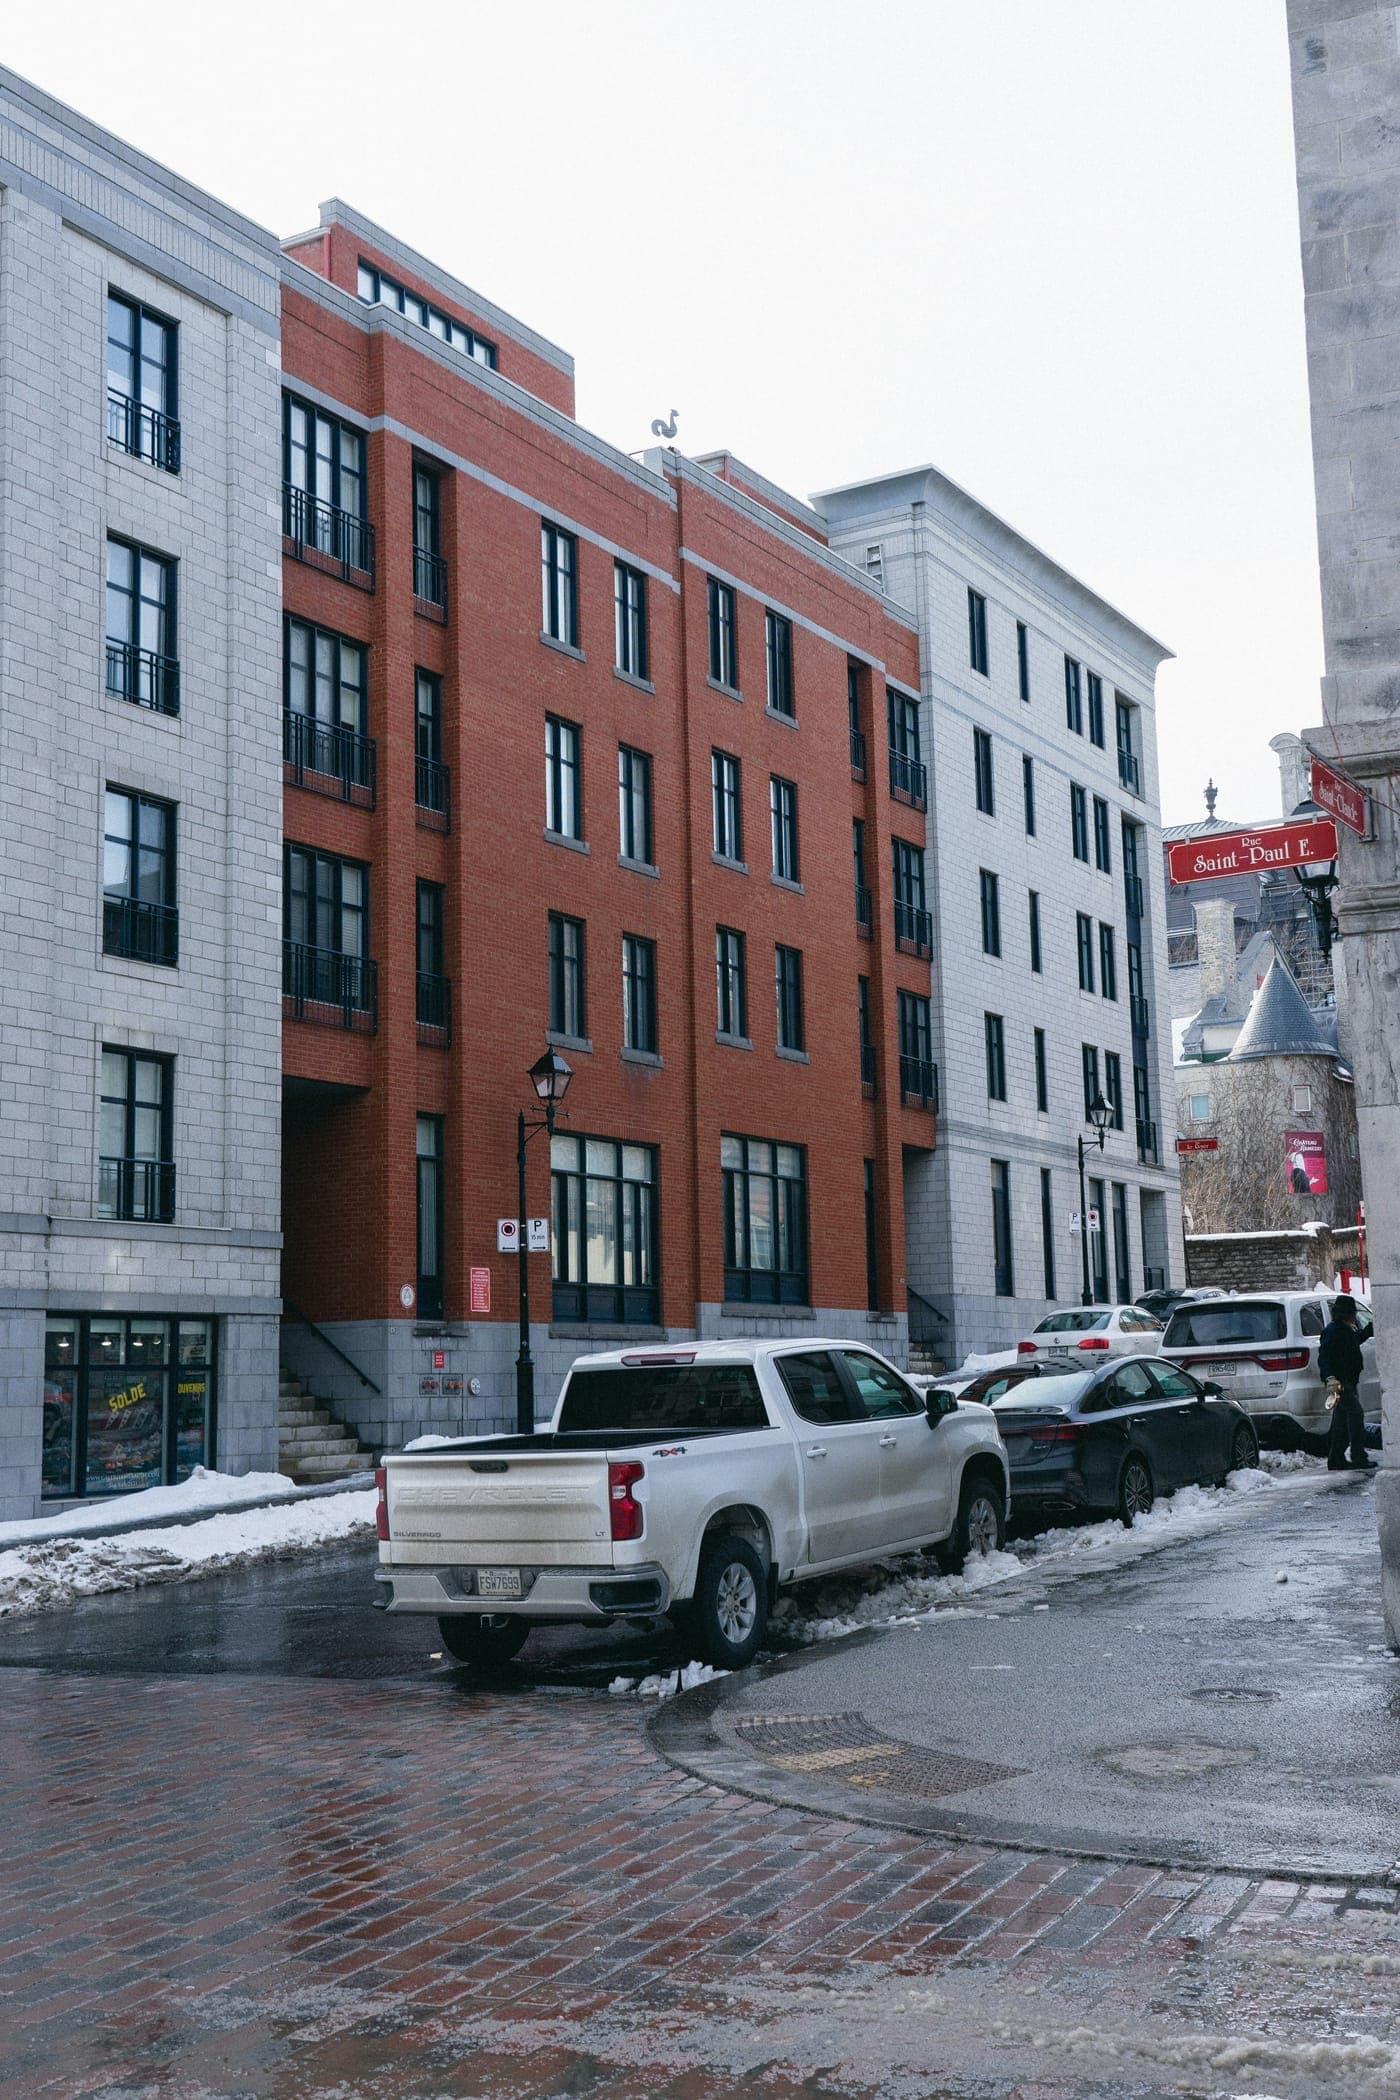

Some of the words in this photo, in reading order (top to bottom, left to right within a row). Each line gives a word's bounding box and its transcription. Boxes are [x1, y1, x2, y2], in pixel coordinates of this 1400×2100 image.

[1334, 779, 1342, 792] Rue
[1318, 780, 1358, 823] Saint-Claude
[1241, 837, 1262, 848] Rue
[1193, 841, 1290, 873] Saint-Paul
[1298, 838, 1315, 857] E.
[1072, 1212, 1078, 1221] P
[533, 1220, 542, 1232] P
[177, 1382, 206, 1394] OUVENIRS
[108, 1382, 147, 1412] SOLDE
[397, 1486, 590, 1504] CHEVROLET
